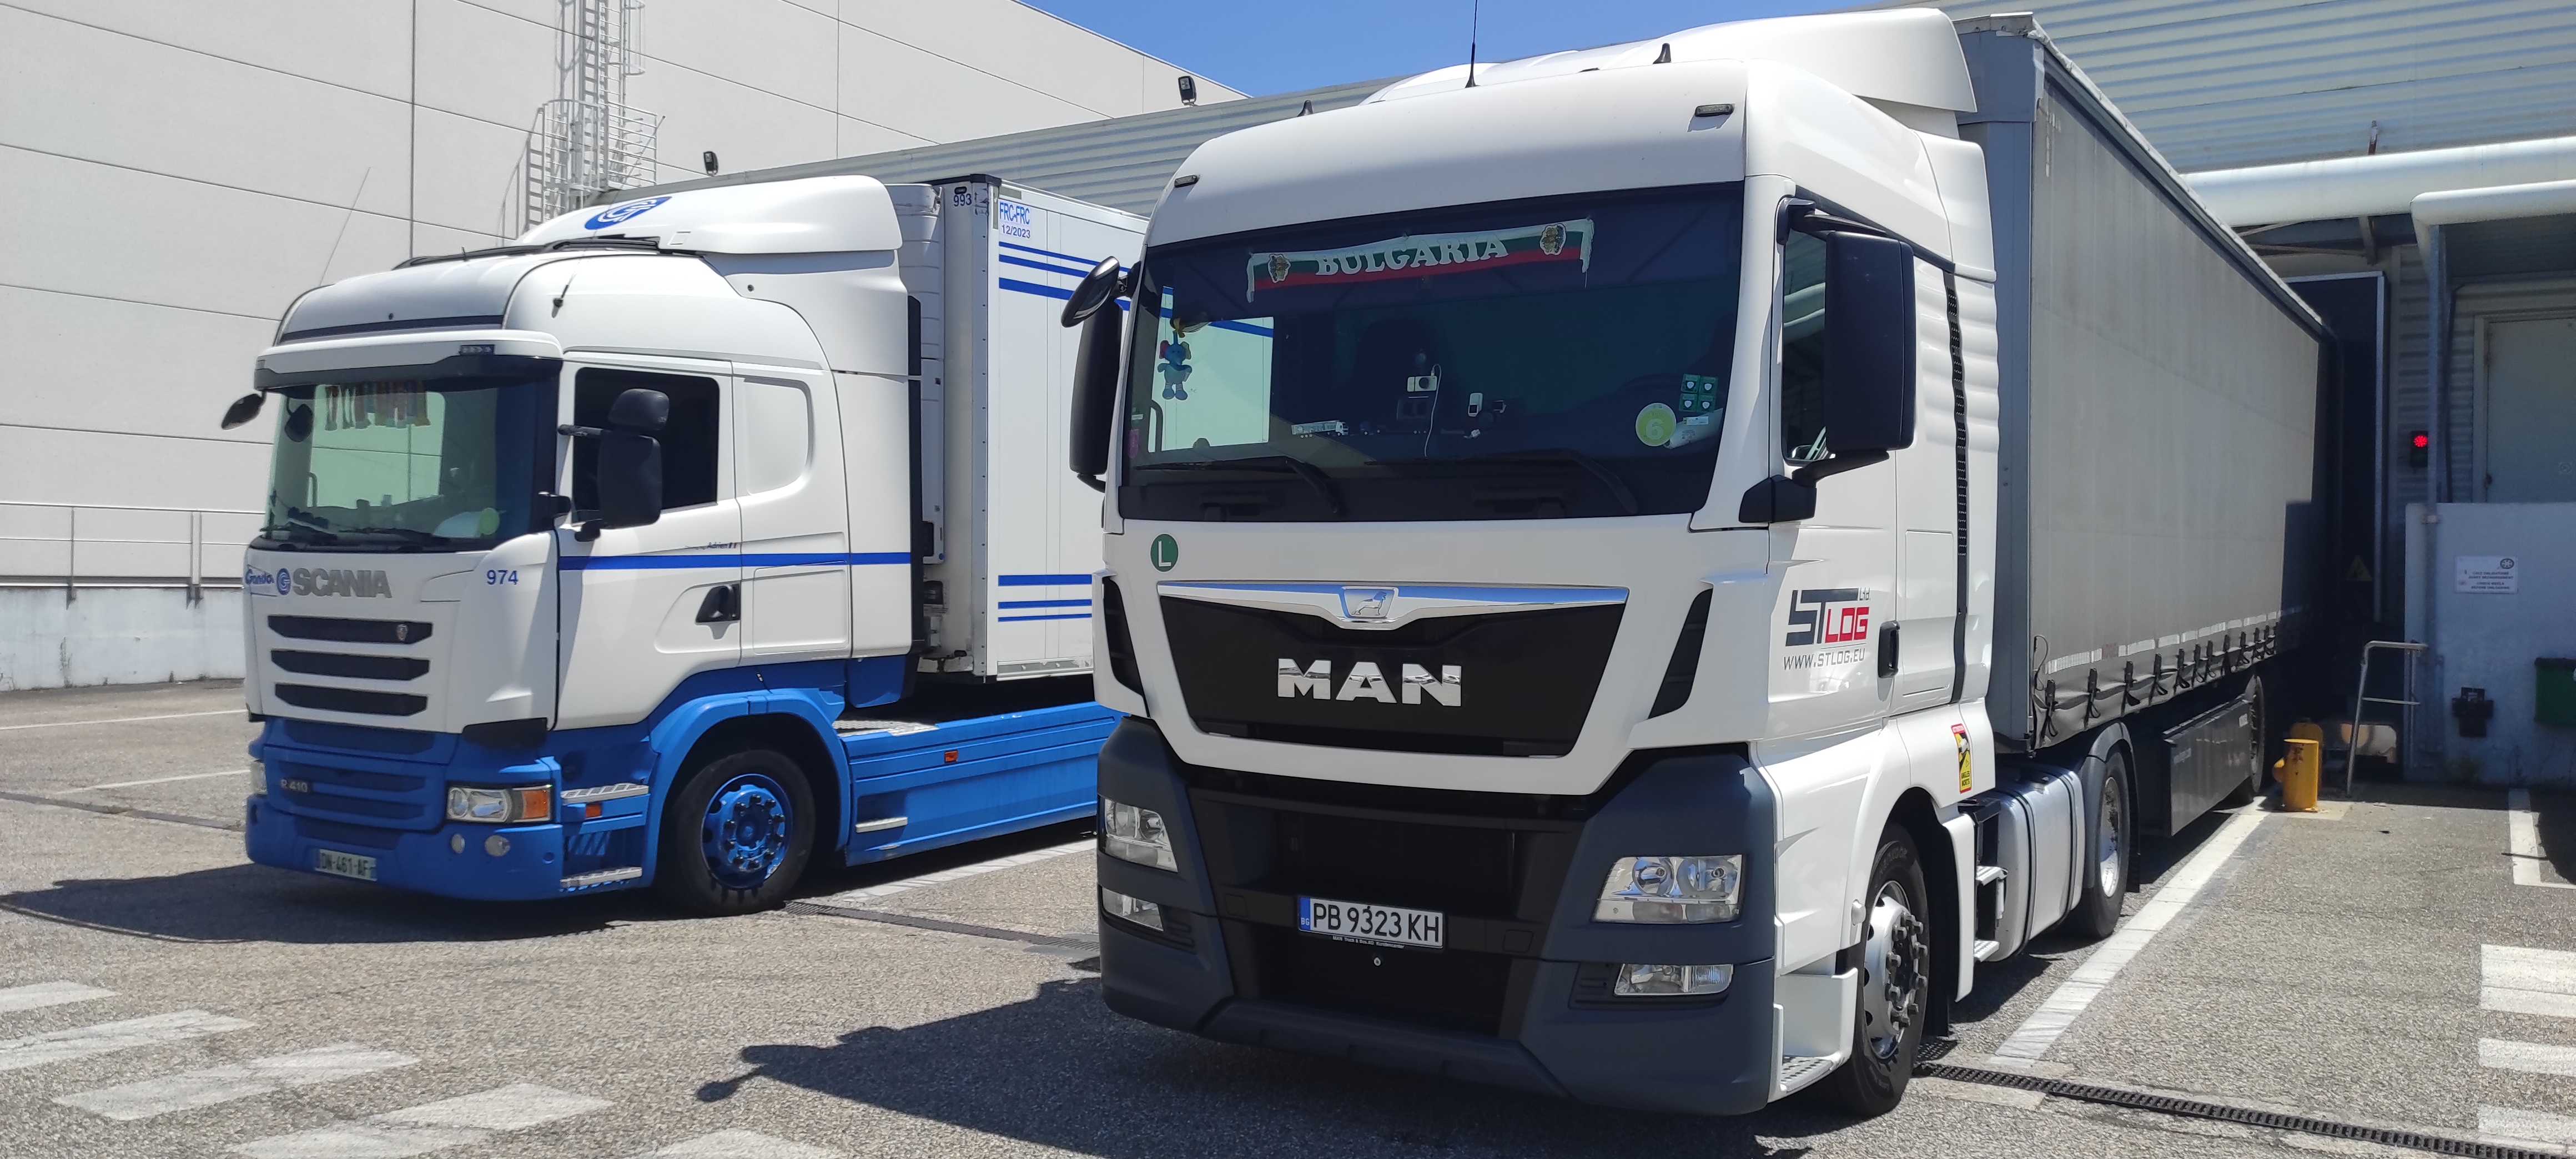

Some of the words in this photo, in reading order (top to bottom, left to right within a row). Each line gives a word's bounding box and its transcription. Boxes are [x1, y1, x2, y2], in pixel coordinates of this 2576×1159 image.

[953, 194, 972, 207] 993
[1000, 202, 1030, 225] FRC-FRC
[1002, 224, 1031, 239] 12/2023
[1316, 234, 1509, 276] BULGARIA
[1646, 419, 1664, 440] 6
[1158, 540, 1171, 567] L
[293, 568, 393, 598] SCANIA
[487, 570, 519, 585] 974
[1784, 647, 1865, 671] WWW.STLOG.EU
[1277, 658, 1462, 707] MAN
[1301, 917, 1310, 926] BG
[1314, 903, 1341, 930] PB
[1347, 907, 1402, 938] 9323
[1408, 913, 1440, 943] KH
